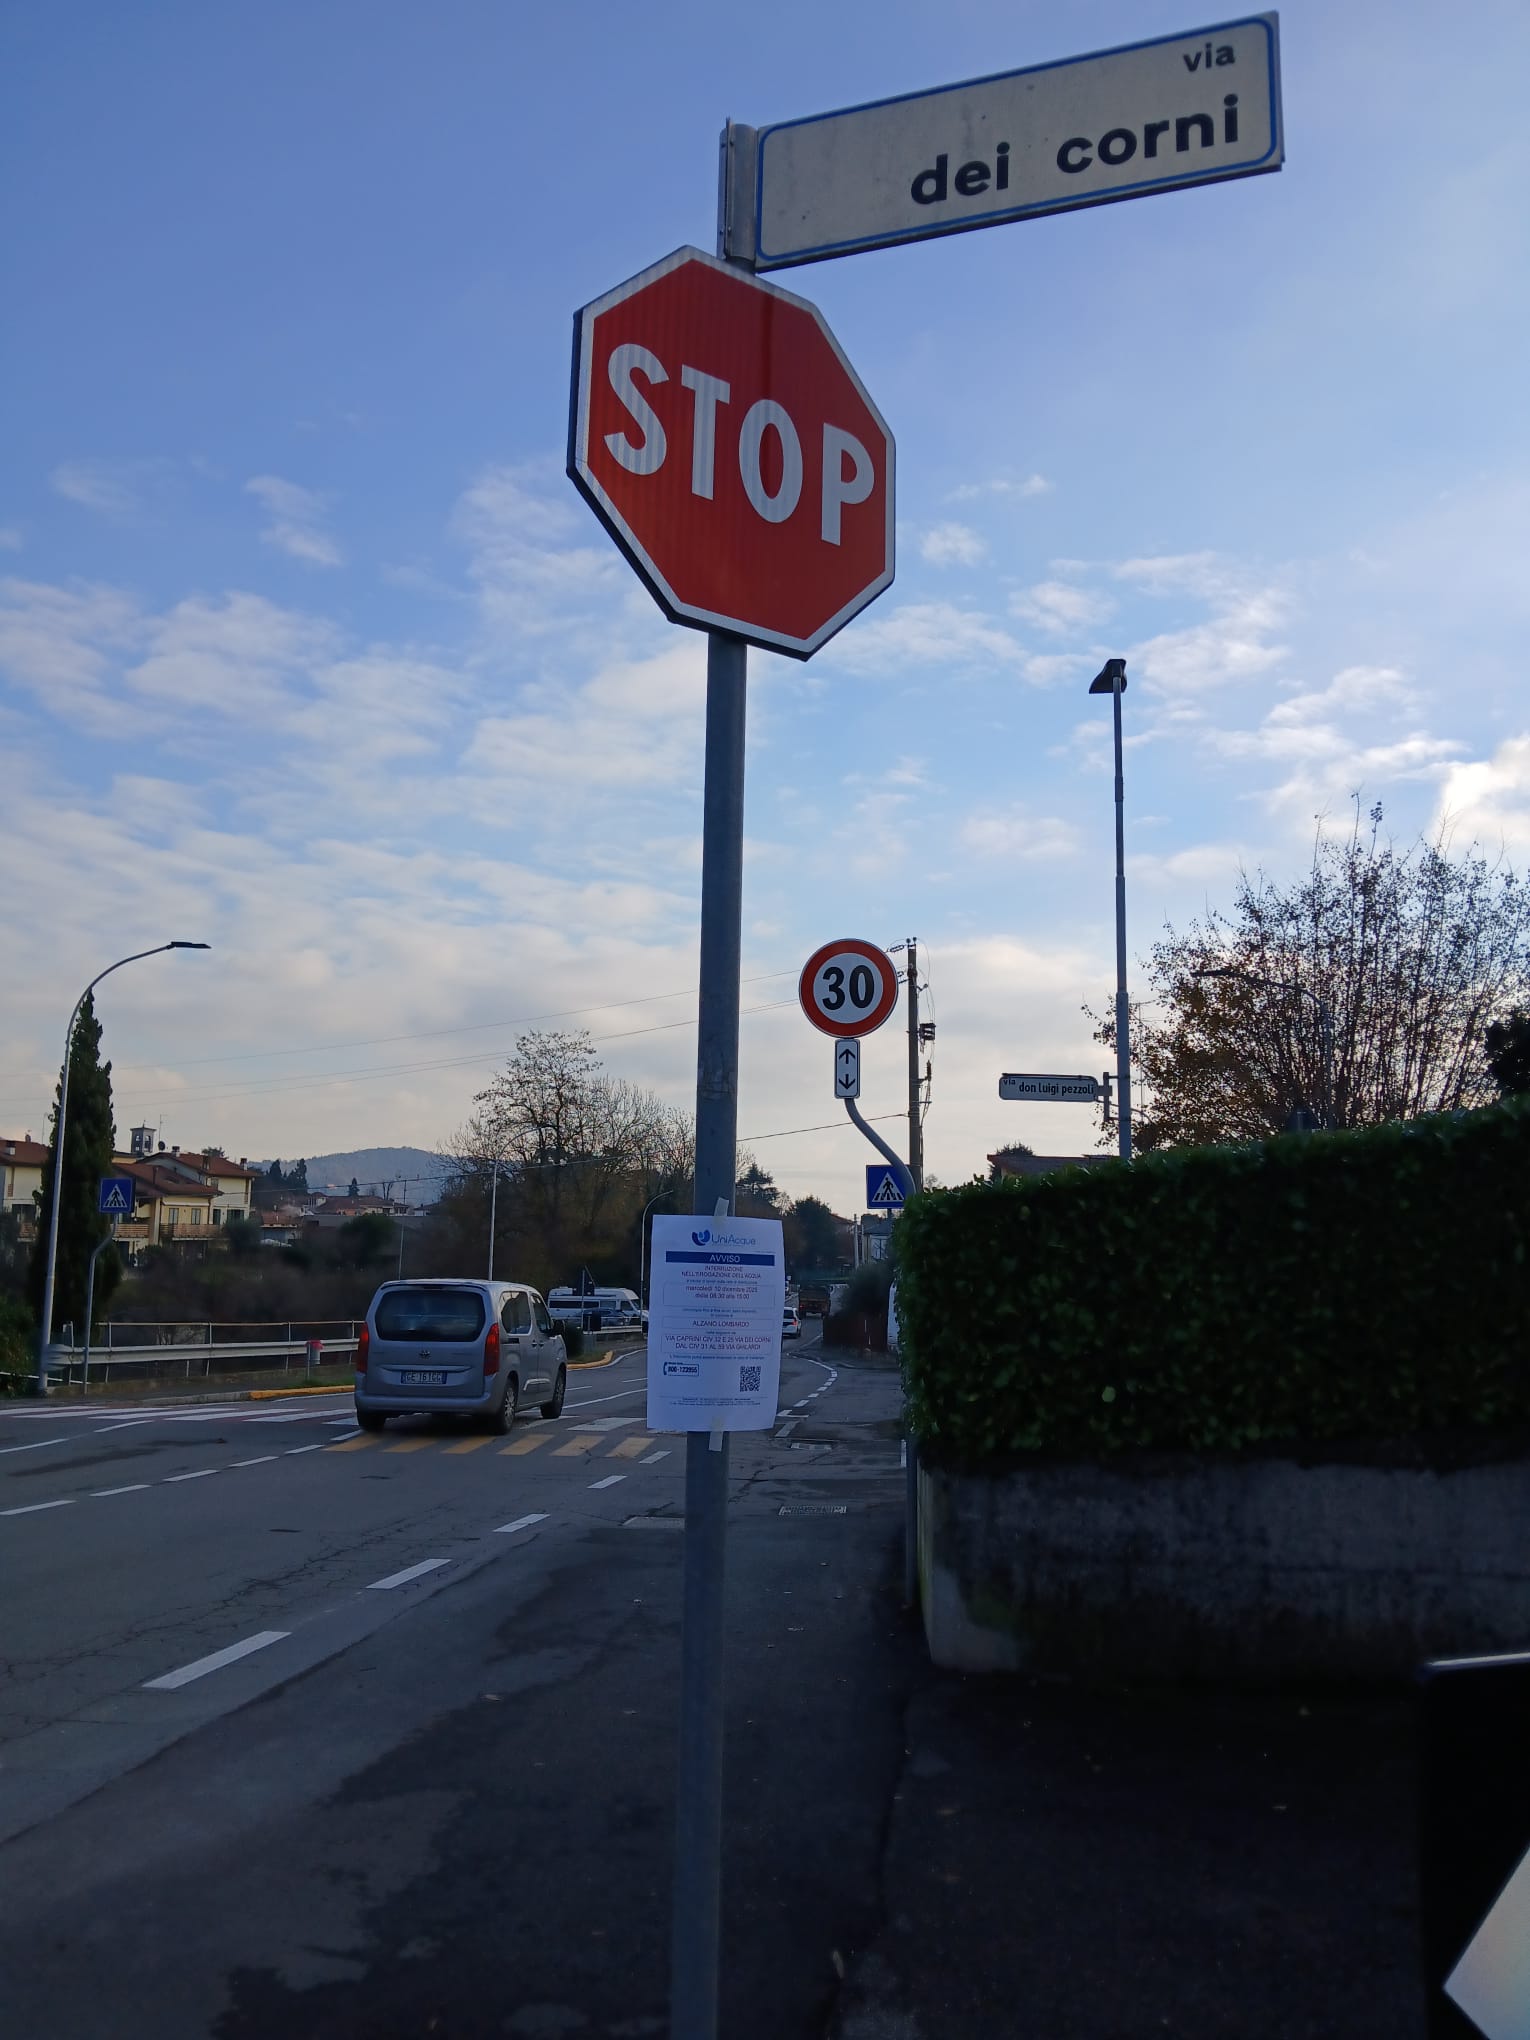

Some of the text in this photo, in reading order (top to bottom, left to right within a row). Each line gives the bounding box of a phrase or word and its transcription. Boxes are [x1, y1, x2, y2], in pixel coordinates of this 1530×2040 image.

[1183, 42, 1236, 73] via
[910, 94, 1239, 205] dei corni
[604, 343, 875, 546] STOP
[822, 964, 874, 1010] 30
[1003, 1078, 1016, 1086] via
[1019, 1082, 1036, 1093] don
[1061, 1084, 1094, 1097] pezzoli
[711, 1233, 756, 1245] UniAcque
[709, 1254, 741, 1263] AVVISO
